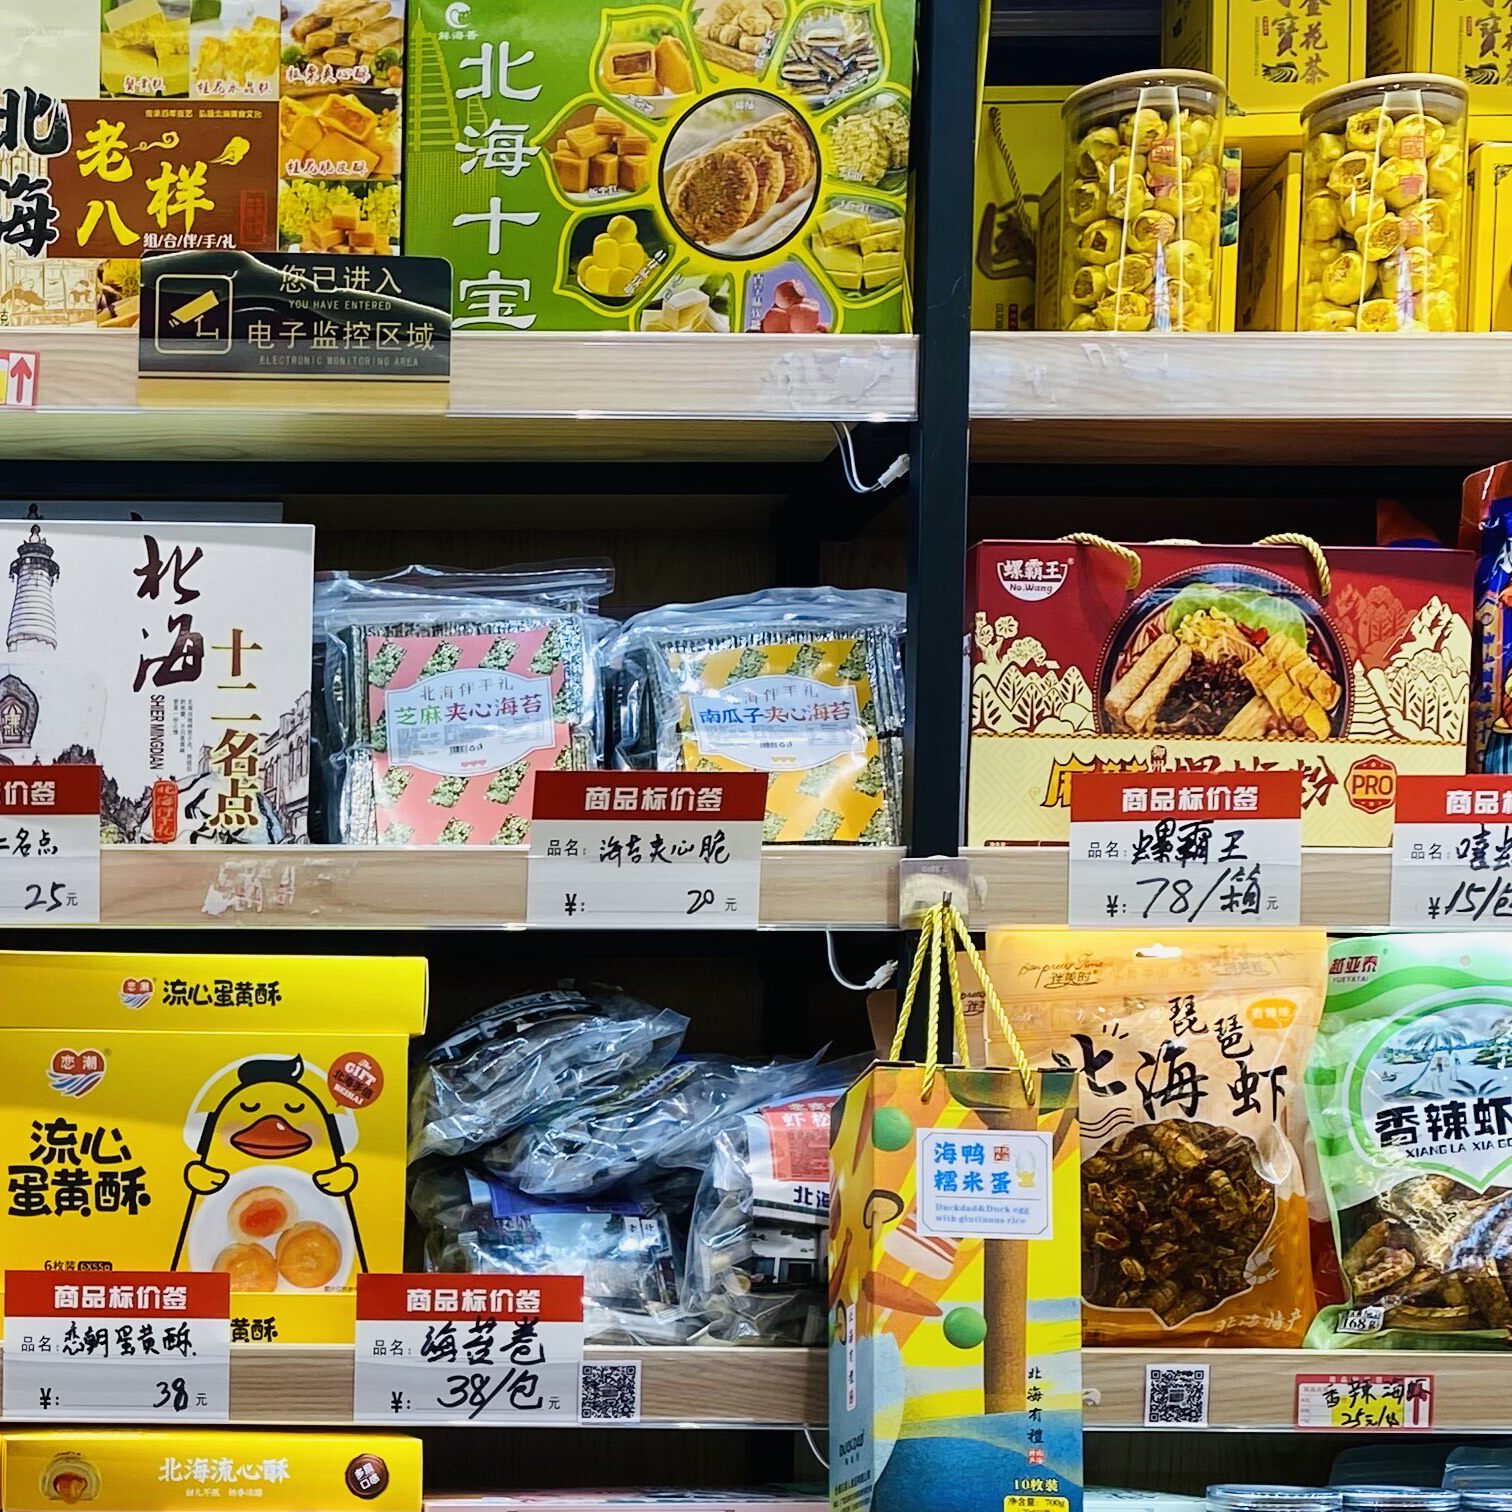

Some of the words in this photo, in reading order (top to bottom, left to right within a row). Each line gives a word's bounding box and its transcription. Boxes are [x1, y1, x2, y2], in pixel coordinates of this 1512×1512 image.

[452, 41, 543, 331] 北海十宝
[279, 264, 402, 296] 您已进入
[289, 300, 309, 311] YOU
[313, 300, 339, 311] HAVE
[343, 301, 392, 311] ENTERED
[247, 320, 435, 352] 电子监控区域
[134, 535, 205, 693] 北海
[395, 694, 543, 726] 芝麻夹心海苔
[699, 701, 851, 725] 南瓜子夹心海苔
[210, 628, 264, 829] 十二名点
[1352, 774, 1393, 796] PRO
[585, 787, 723, 812] 商品标价签
[1121, 786, 1259, 813] 商品标价签
[24, 882, 66, 912] 25
[687, 889, 714, 914] 20
[163, 980, 282, 1007] 流心蛋黄酥
[61, 1055, 98, 1071] 恋潮
[29, 1117, 132, 1166] 流心
[934, 1141, 986, 1166] 海鸭
[8, 1165, 152, 1218] 蛋黄酥
[934, 1169, 1012, 1195] 糯米蛋
[54, 1286, 188, 1312] 商品标价签
[406, 1288, 542, 1313] 商品标价签
[153, 1377, 189, 1412] 38
[158, 1457, 291, 1484] 北海流心酥
